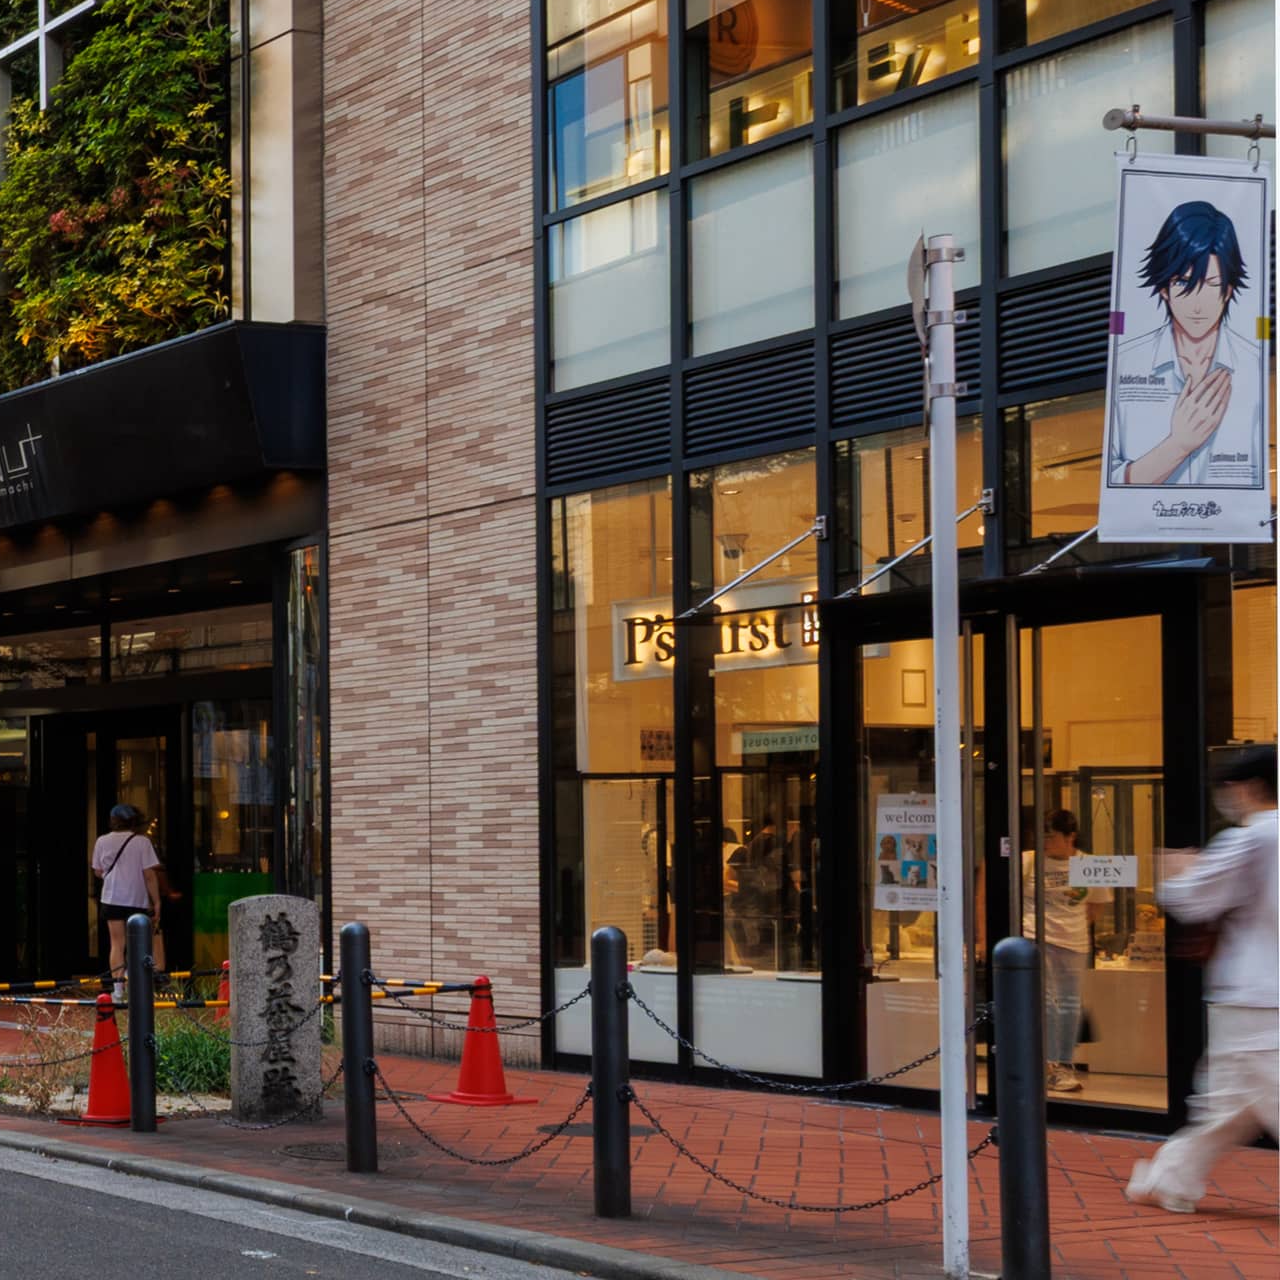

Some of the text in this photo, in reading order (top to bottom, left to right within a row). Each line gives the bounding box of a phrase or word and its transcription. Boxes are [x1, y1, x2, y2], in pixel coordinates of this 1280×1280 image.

[622, 614, 676, 667] P's
[884, 810, 936, 824] welcom
[1082, 866, 1122, 878] OPEN
